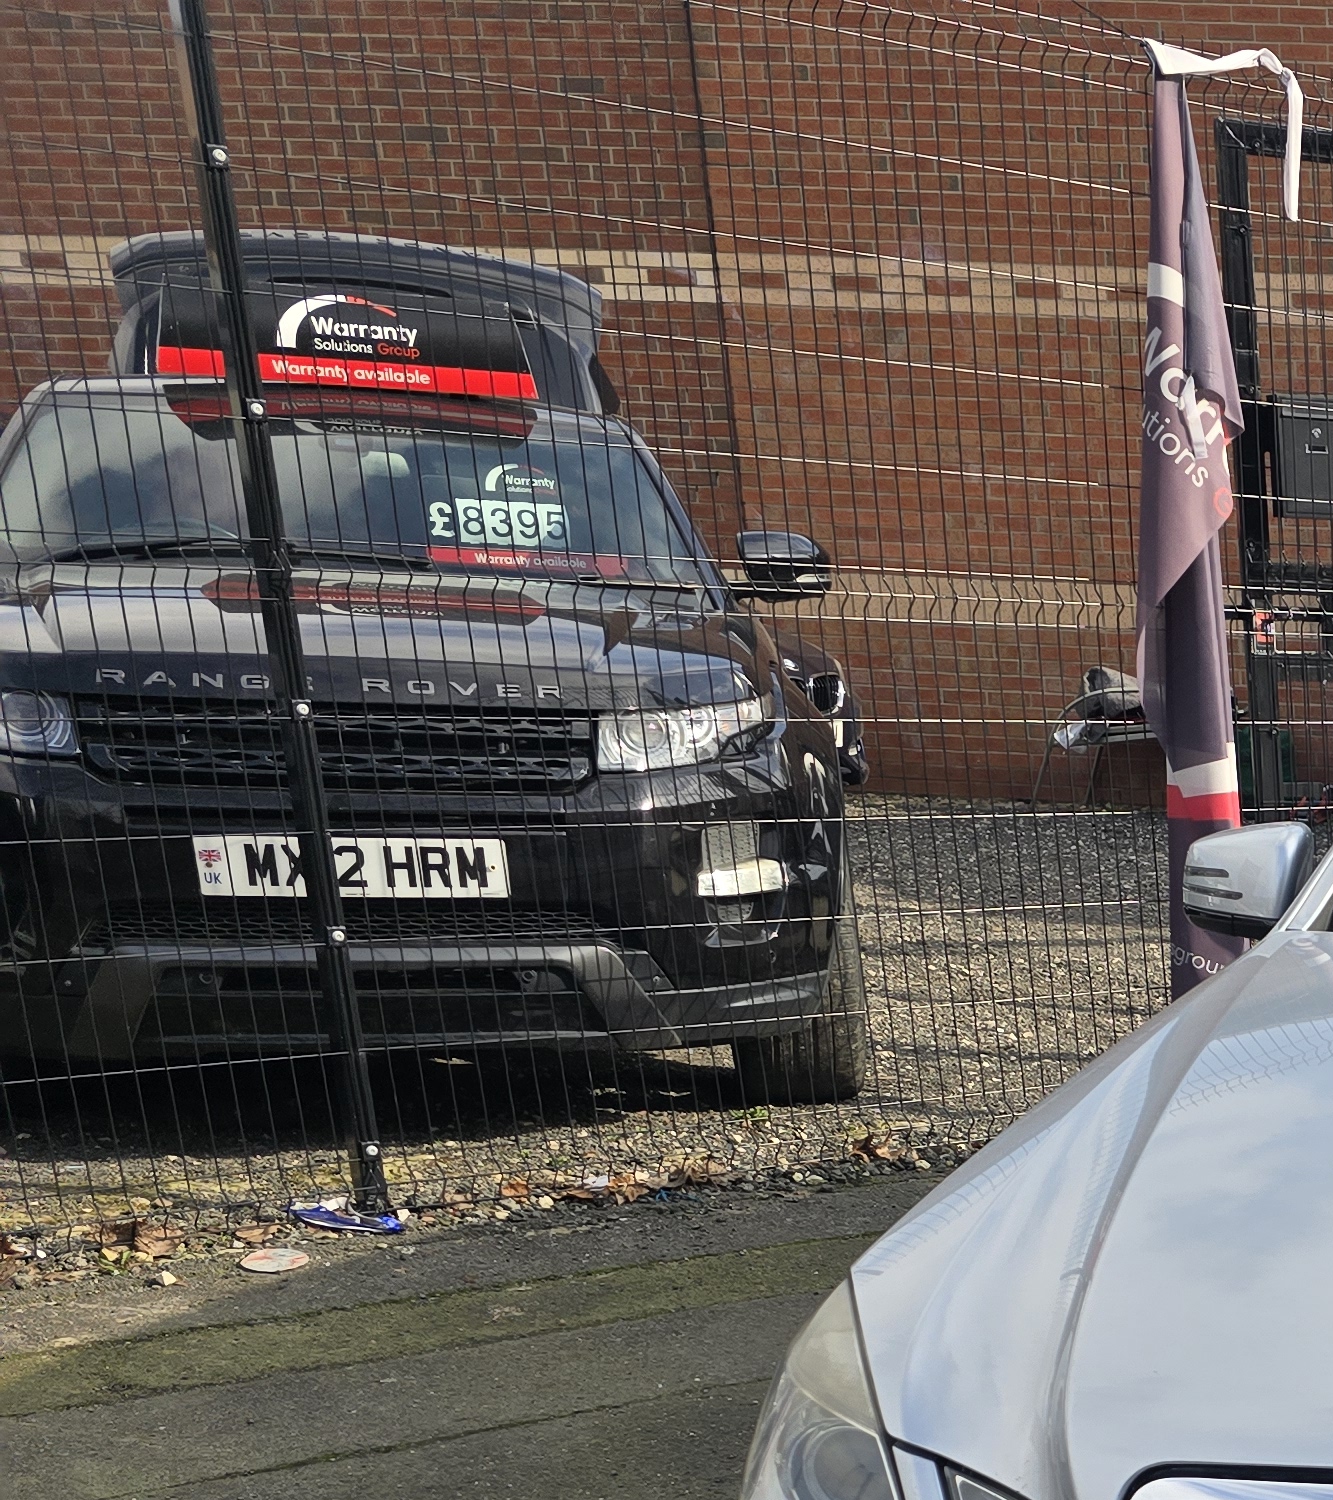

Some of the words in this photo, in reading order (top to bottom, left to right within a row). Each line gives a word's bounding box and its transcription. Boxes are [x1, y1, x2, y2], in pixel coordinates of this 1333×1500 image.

[310, 315, 418, 348] Warranty
[314, 337, 373, 355] Solutions
[377, 342, 421, 360] Group
[271, 359, 350, 382] Warranty
[353, 368, 431, 386] available
[474, 552, 530, 567] Warranty
[533, 558, 587, 569] available
[361, 677, 563, 699] ROVER
[204, 870, 223, 884] UK
[244, 843, 369, 888] MX2
[385, 846, 489, 888] HRM
